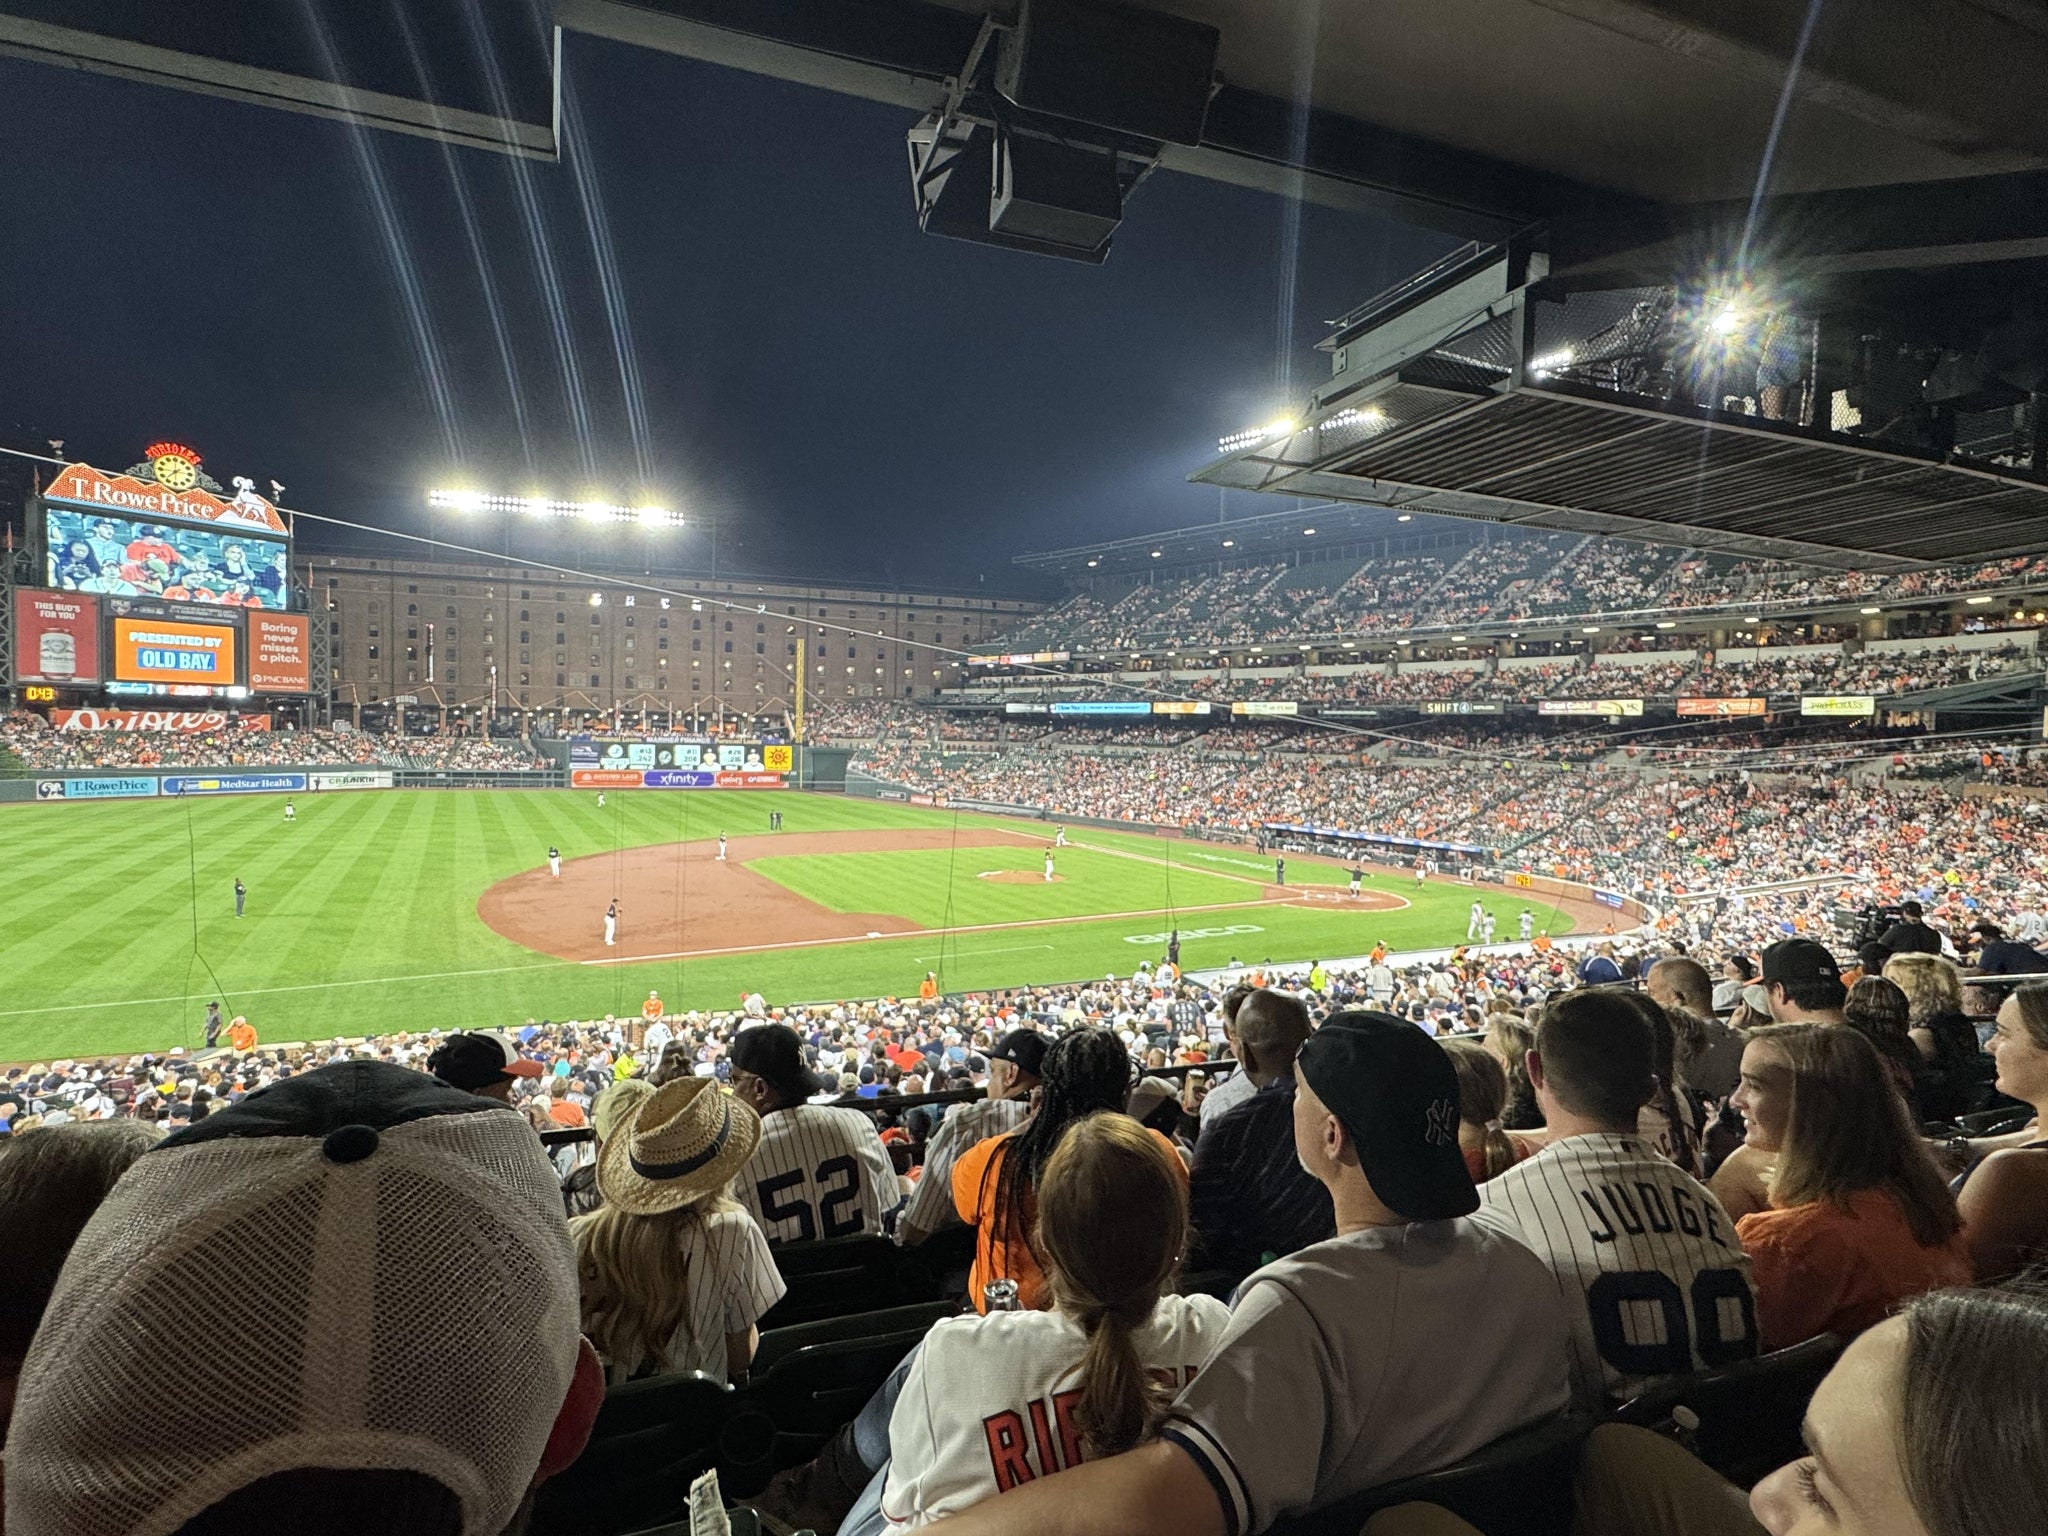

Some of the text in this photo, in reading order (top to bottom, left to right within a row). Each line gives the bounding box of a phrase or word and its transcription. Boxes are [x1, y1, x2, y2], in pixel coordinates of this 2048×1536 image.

[68, 476, 215, 519] T. Rowe Price
[34, 602, 81, 613] THIS BUD'S
[40, 610, 76, 620] FOR YOU
[261, 622, 298, 635] Boring
[129, 632, 222, 648] PRESENTED BY
[263, 634, 296, 643] never
[260, 643, 299, 653] misses
[142, 650, 176, 669] OLD
[259, 653, 302, 664] a pitch.
[263, 675, 306, 684] PNC BANK
[1427, 702, 1459, 714] SHIFT
[222, 779, 260, 789] MedStar
[262, 778, 292, 788] Health
[660, 772, 699, 786] xfinity
[84, 781, 118, 790] Rowe
[119, 780, 148, 790] Price
[757, 1154, 865, 1244] 52
[1581, 1182, 1727, 1248] JUDGE
